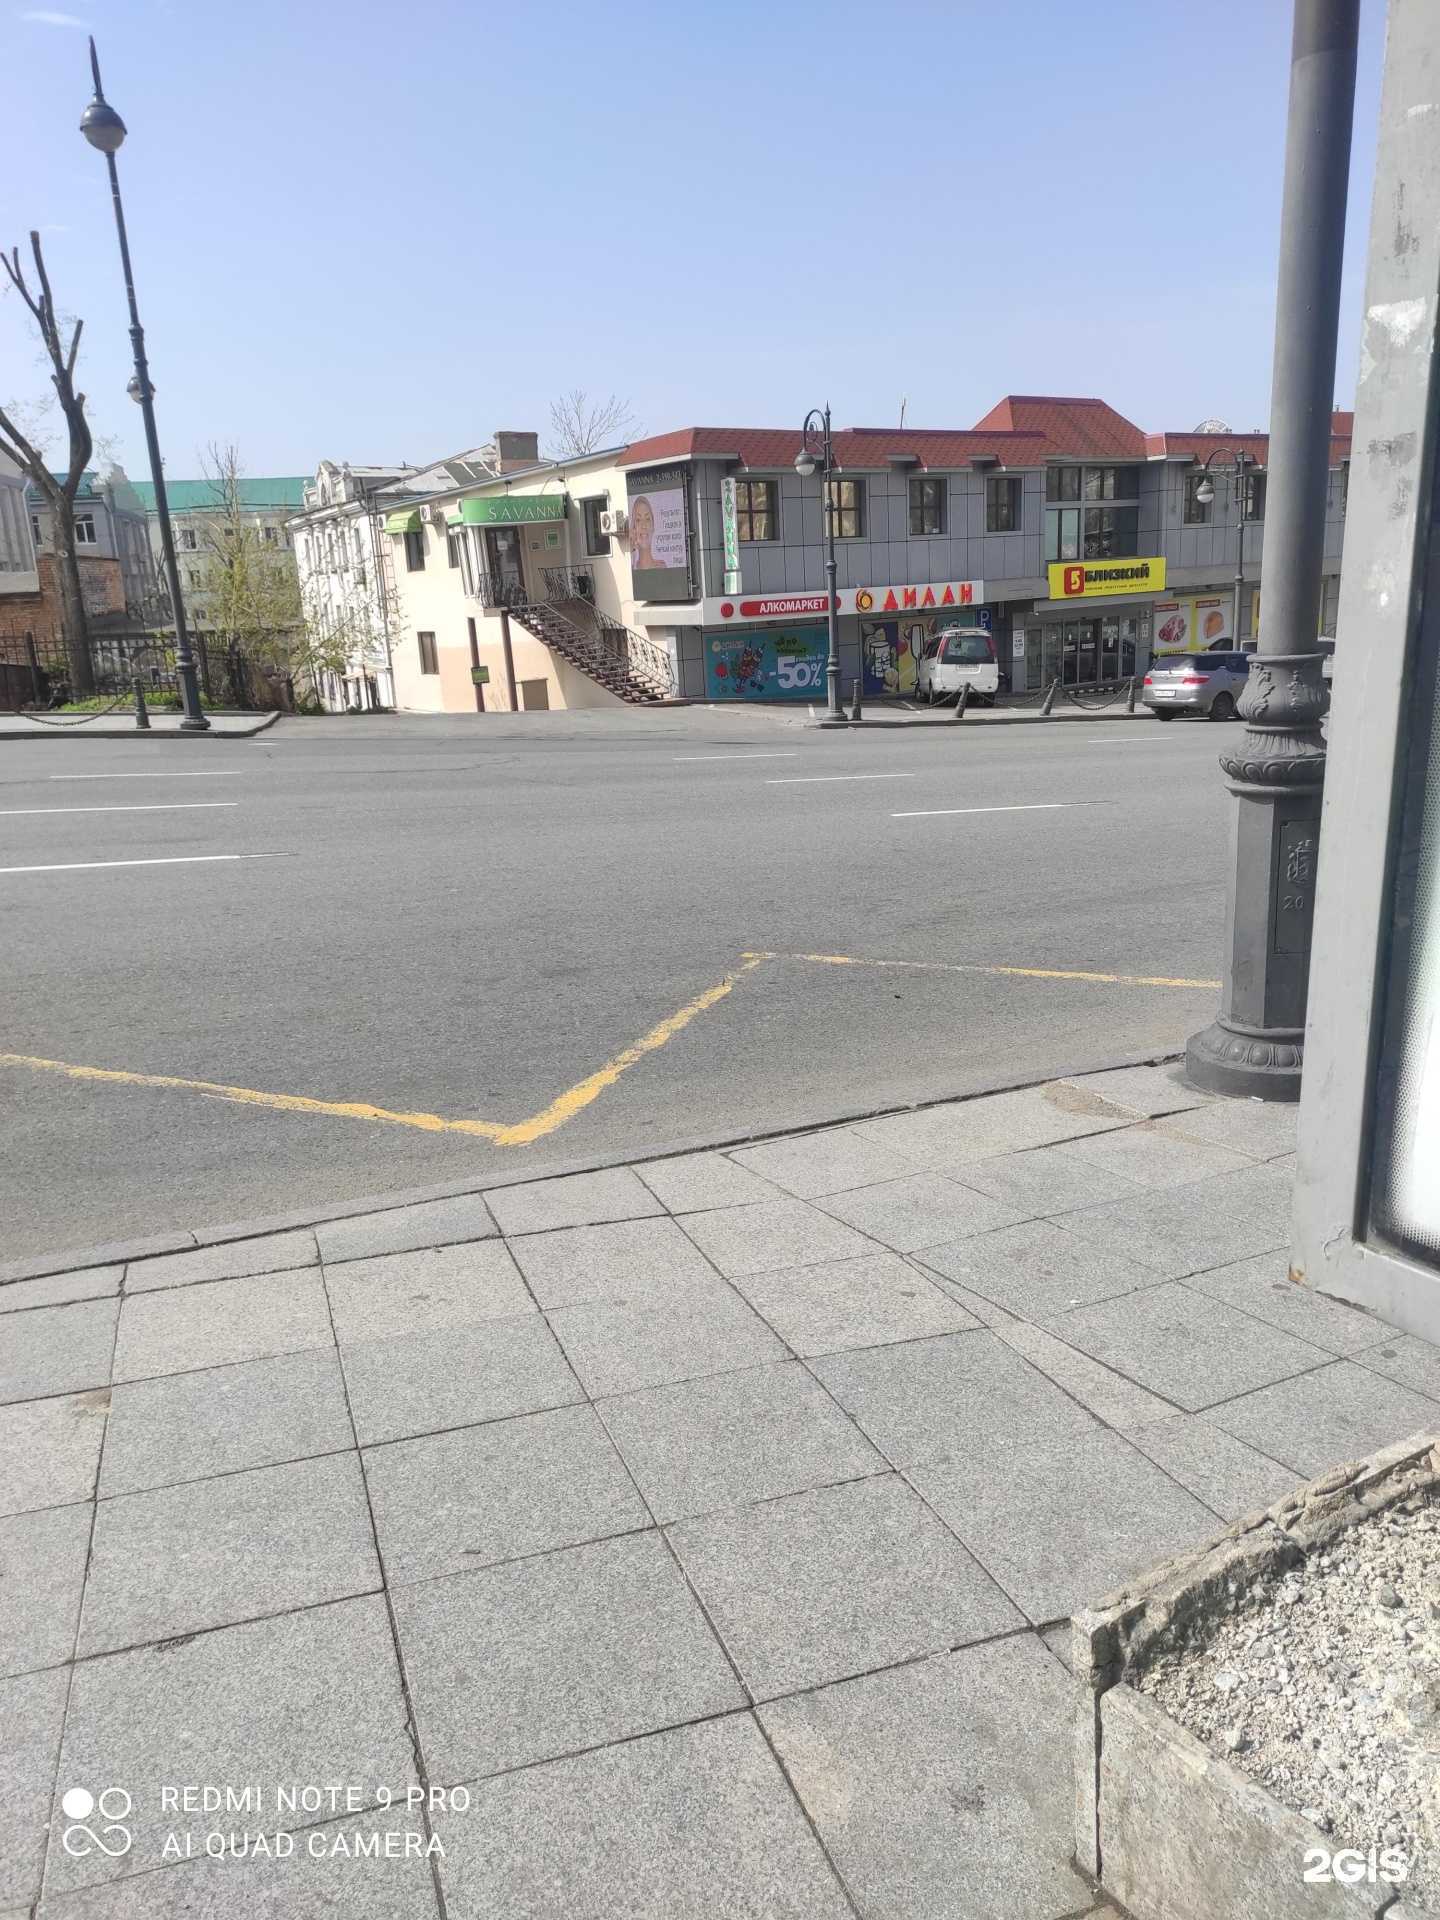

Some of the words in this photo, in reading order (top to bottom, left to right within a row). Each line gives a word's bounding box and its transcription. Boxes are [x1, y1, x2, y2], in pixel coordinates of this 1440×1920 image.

[1084, 563, 1150, 582] БЛИЗКИЙ
[759, 598, 825, 614] АЛКОМАРКЕТ
[883, 583, 973, 611] ДИЛАН
[769, 655, 823, 689] -50%
